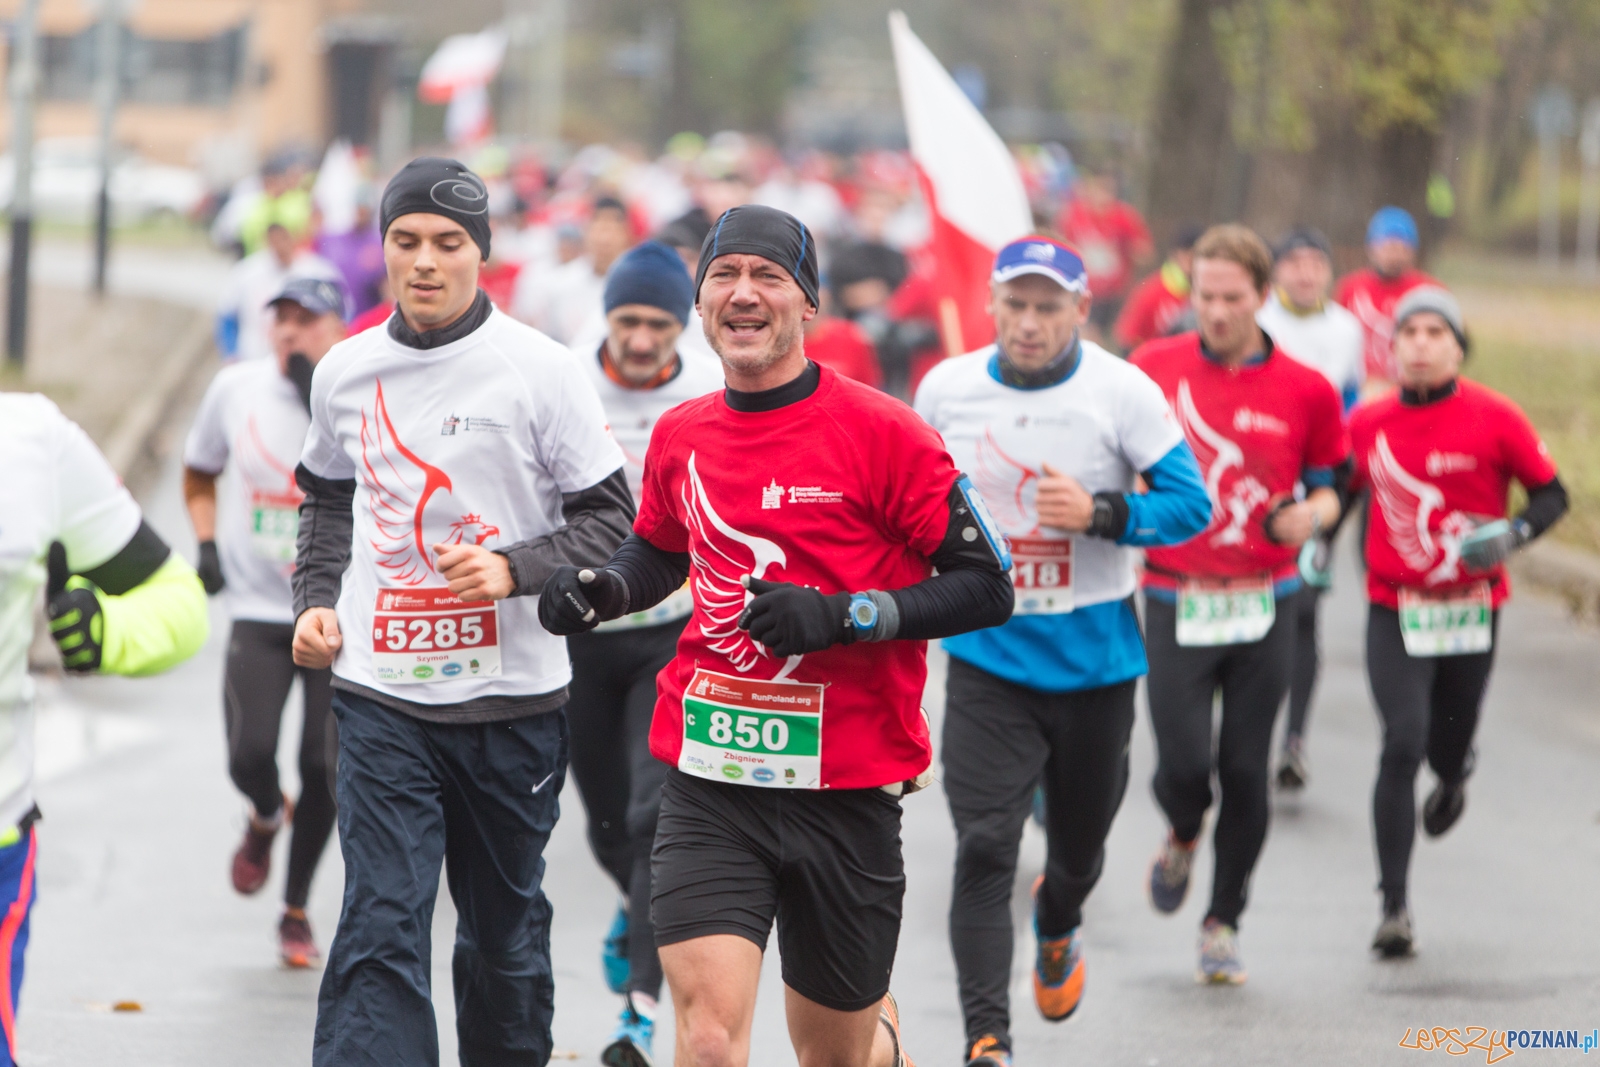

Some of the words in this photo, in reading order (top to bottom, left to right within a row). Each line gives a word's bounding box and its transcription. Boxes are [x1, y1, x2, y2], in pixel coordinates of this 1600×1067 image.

[787, 486, 798, 503] 1
[1009, 561, 1060, 588] 18
[374, 628, 383, 640] B
[386, 616, 484, 651] 5285
[416, 655, 449, 663] Szymon
[751, 692, 811, 706] RunPoland.org
[687, 714, 696, 726] C
[708, 711, 789, 752] 850
[723, 752, 766, 764] Zbigniew
